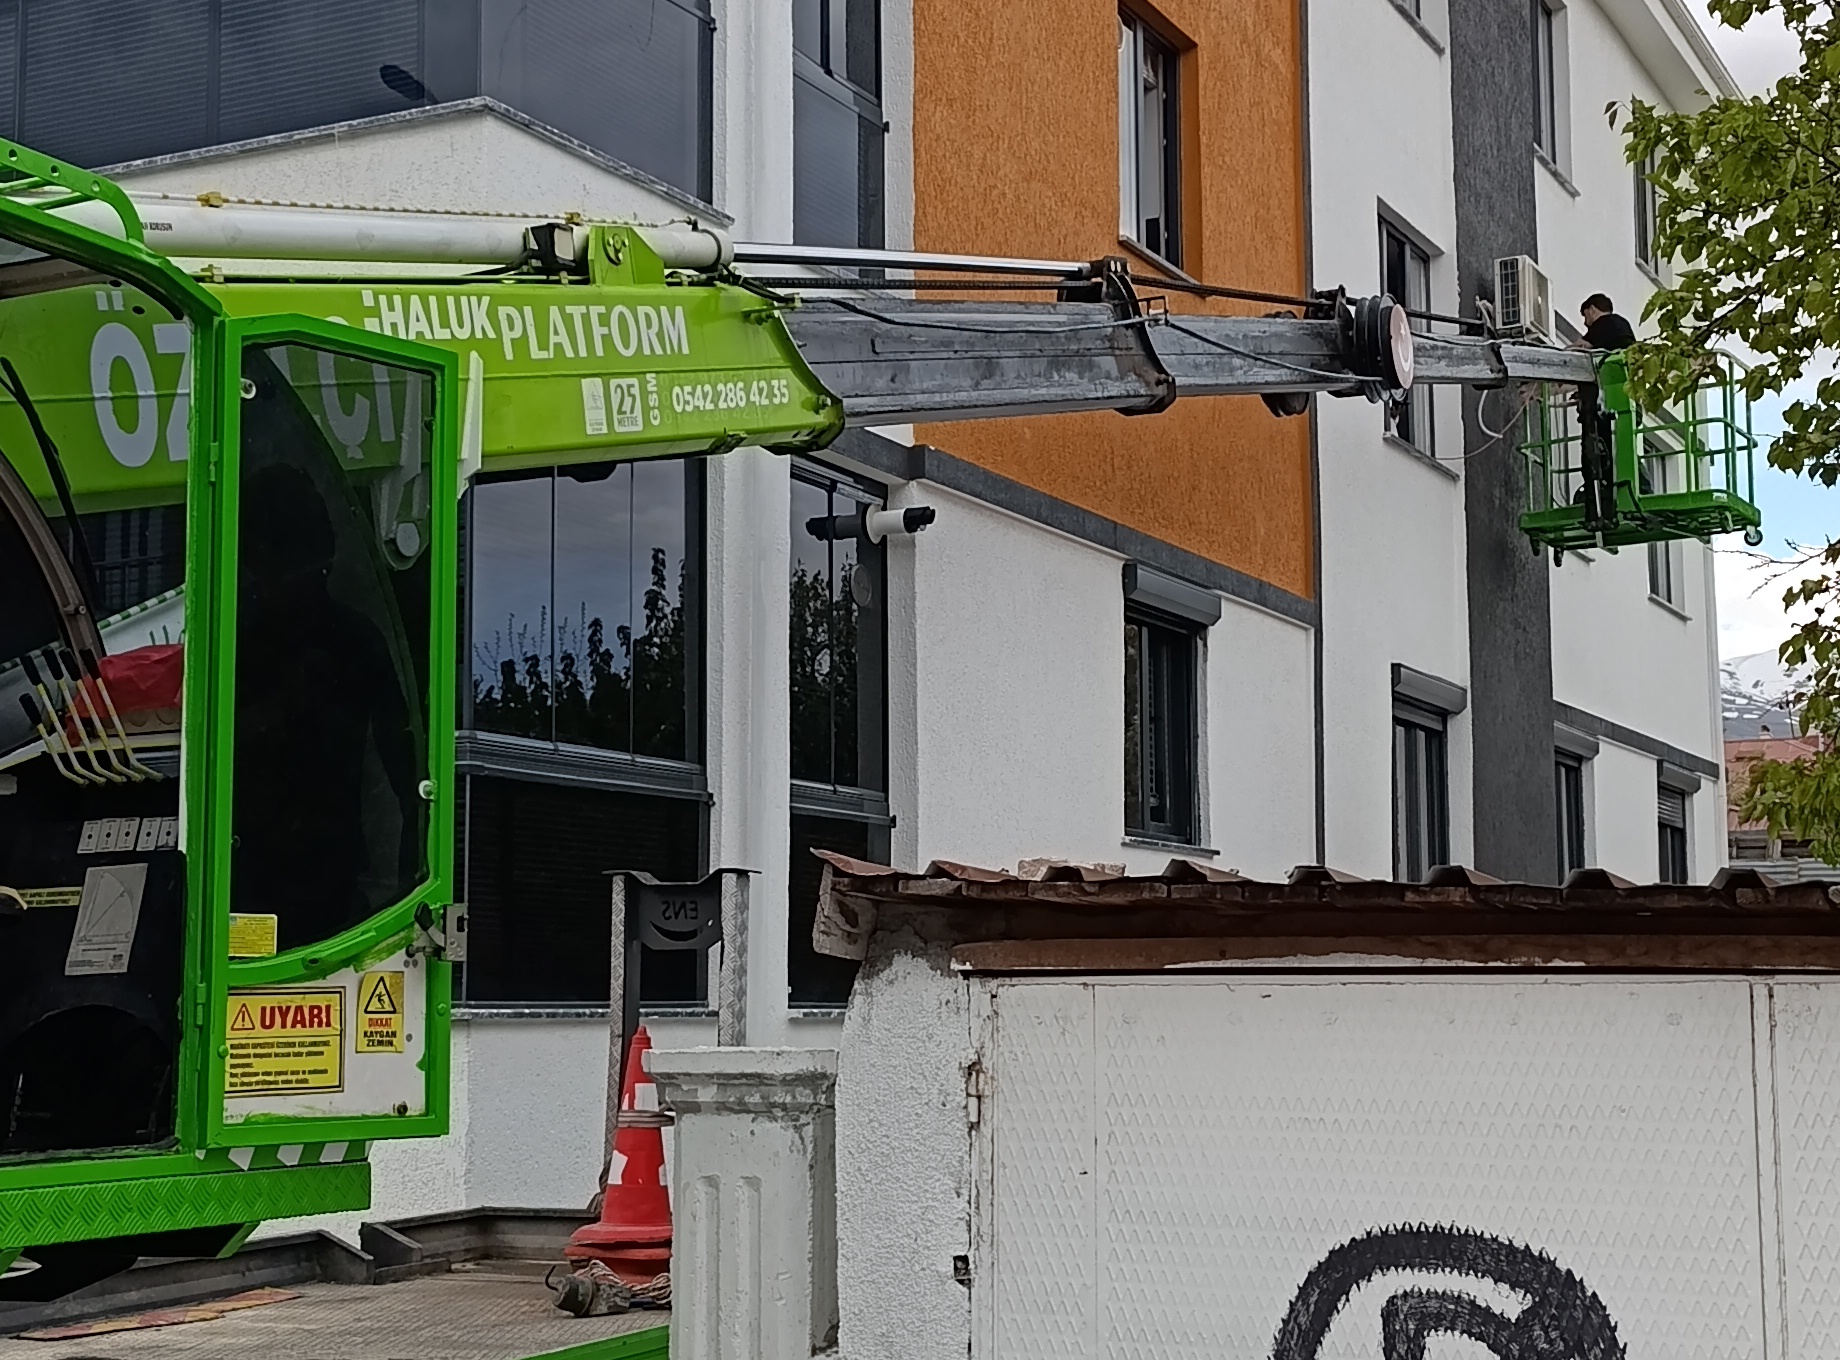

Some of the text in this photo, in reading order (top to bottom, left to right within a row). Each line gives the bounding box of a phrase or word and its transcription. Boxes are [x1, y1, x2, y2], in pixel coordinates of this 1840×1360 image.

[378, 294, 690, 361] HALUK PLATFORM
[614, 383, 638, 416] 25
[645, 373, 660, 426] GSM
[672, 383, 715, 413] 0542
[717, 381, 746, 409] 286
[749, 380, 770, 406] 42
[771, 378, 789, 404] 35
[616, 414, 639, 428] METRE
[260, 1004, 332, 1030] UYARI
